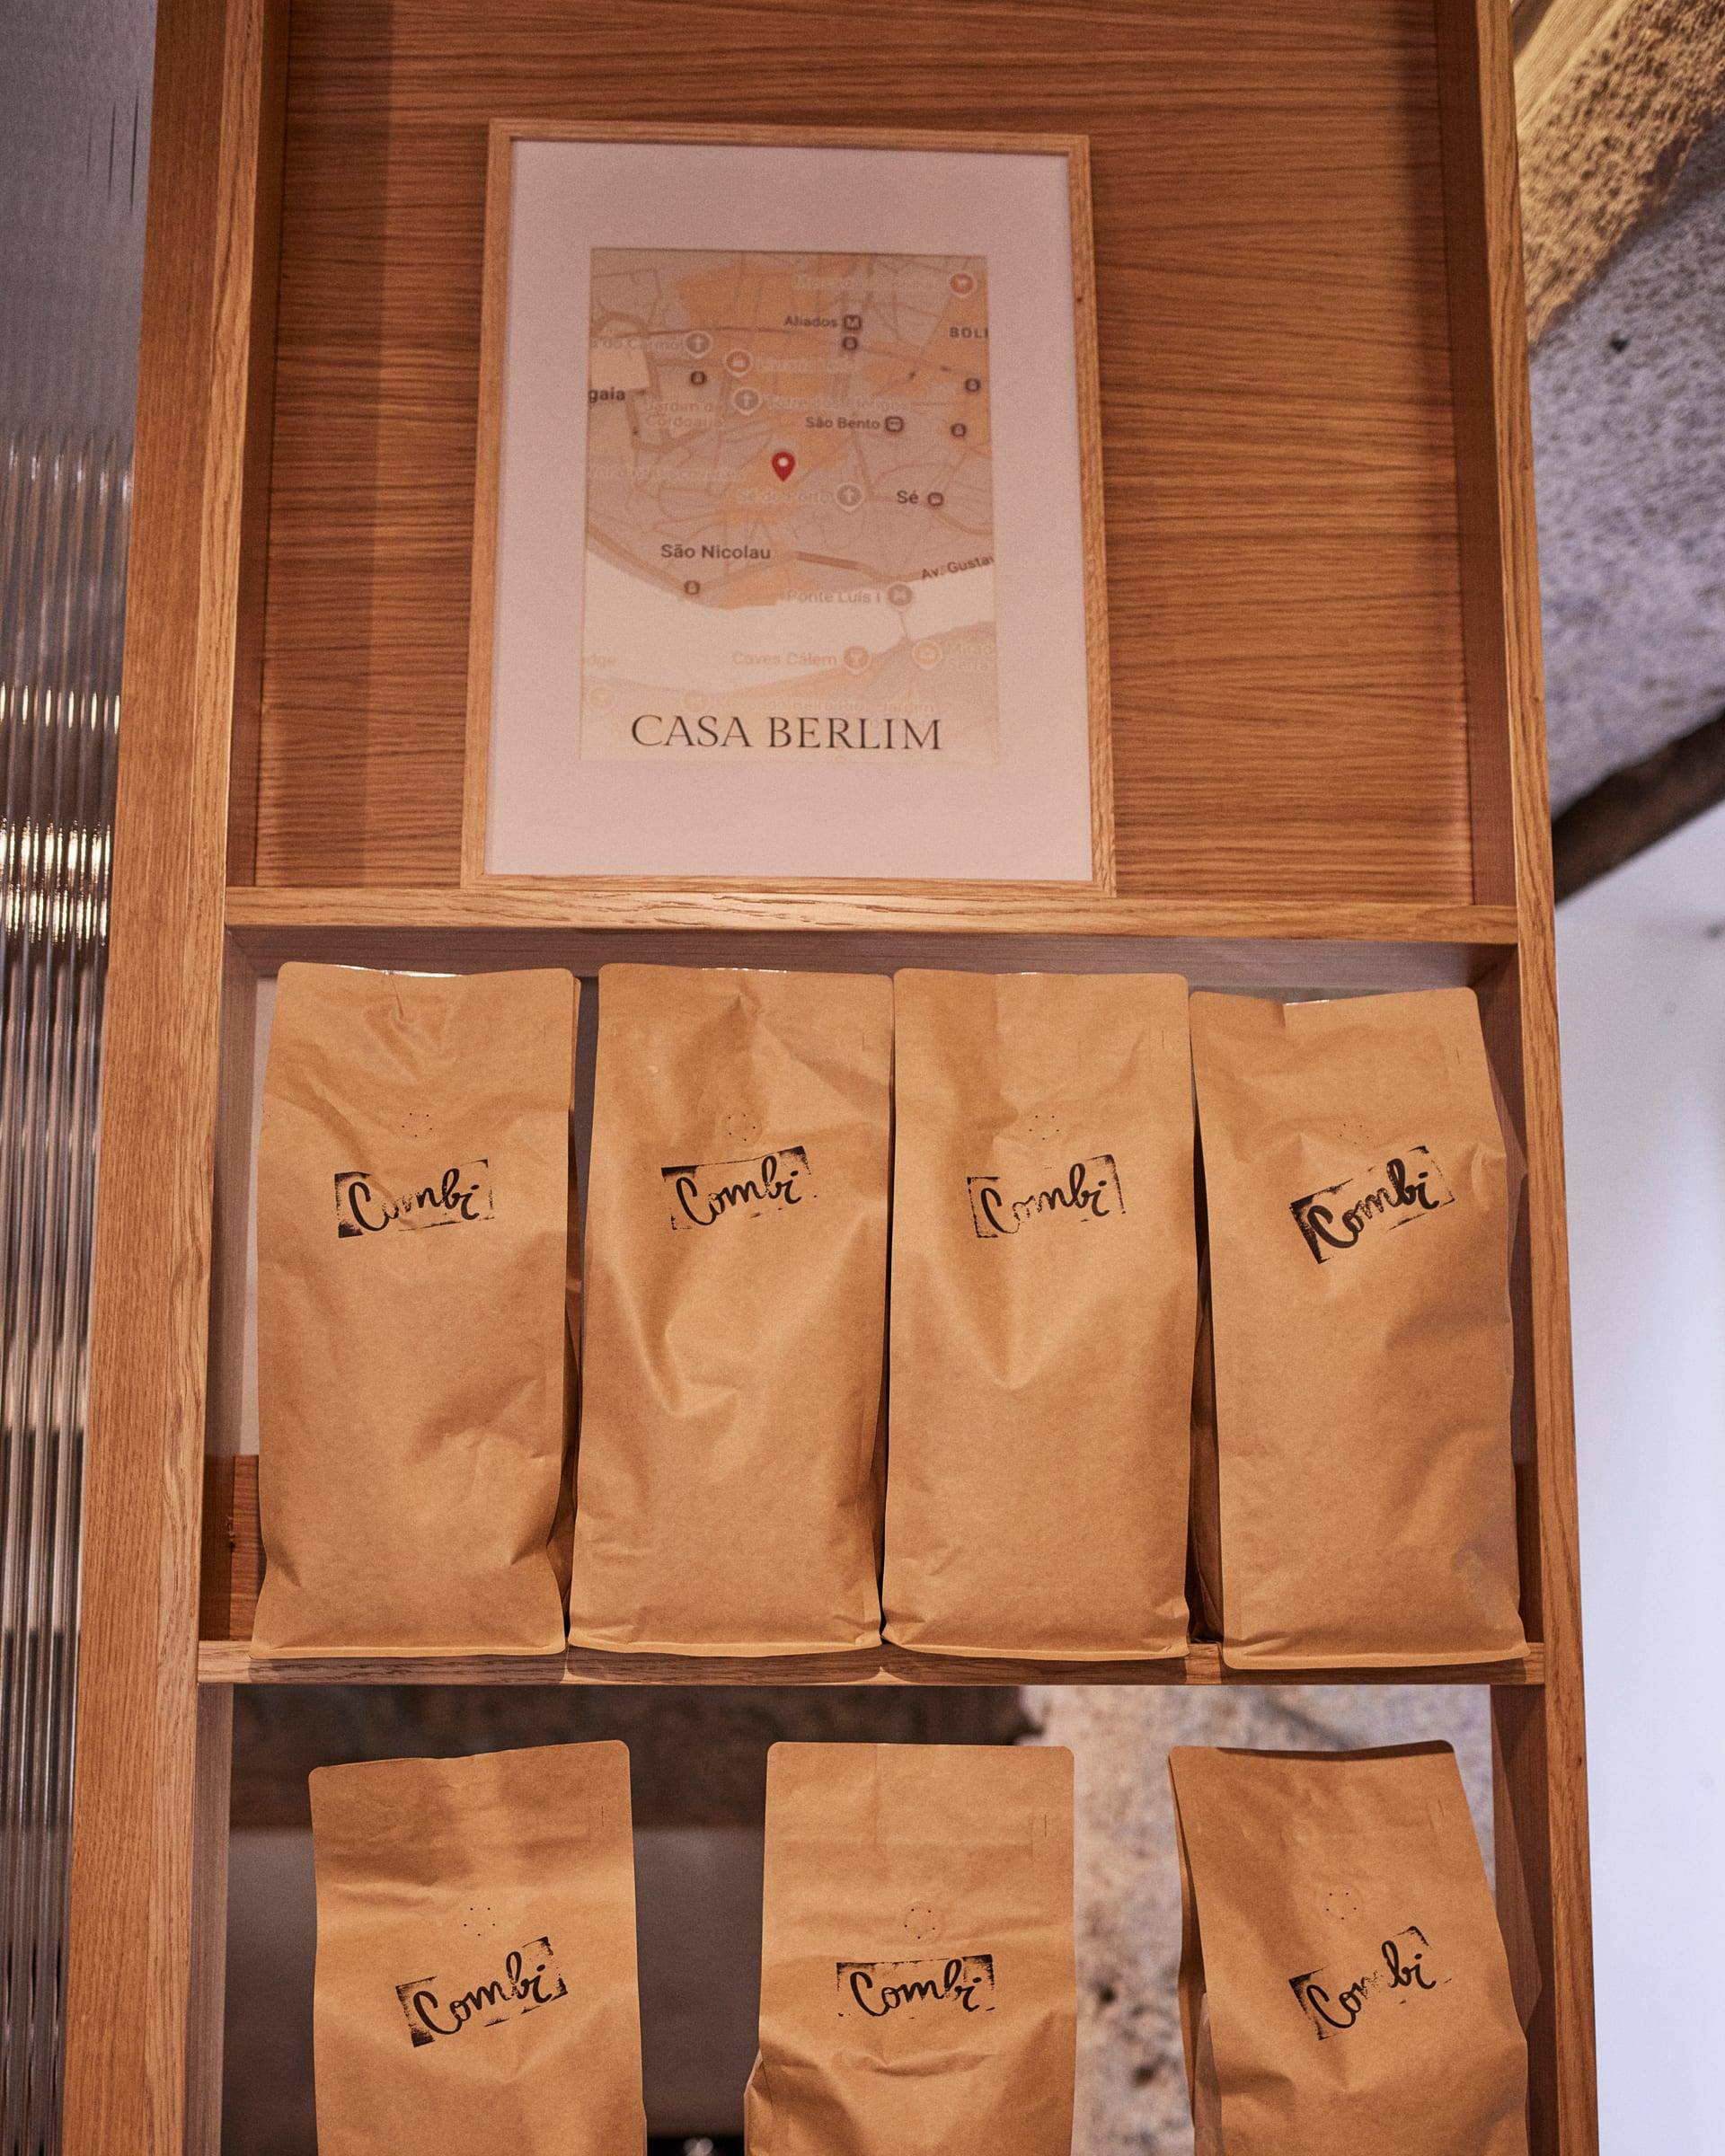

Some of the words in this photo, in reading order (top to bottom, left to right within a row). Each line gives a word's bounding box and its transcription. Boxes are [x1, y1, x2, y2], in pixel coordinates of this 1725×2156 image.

[784, 314, 838, 329] Aliados
[588, 389, 625, 404] gaia
[805, 415, 836, 429] São
[837, 416, 880, 430] Bento
[896, 490, 919, 505] Sé
[661, 543, 697, 560] São
[701, 544, 772, 560] Nicolau
[731, 652, 781, 666] Caves
[632, 714, 751, 749] CASA
[769, 716, 943, 751] BERLIM
[677, 1150, 802, 1226] Combi
[980, 1163, 1110, 1234] Combi
[1308, 1157, 1440, 1250] Combi
[413, 1950, 552, 2037] Combi
[849, 1959, 983, 2017] Combi
